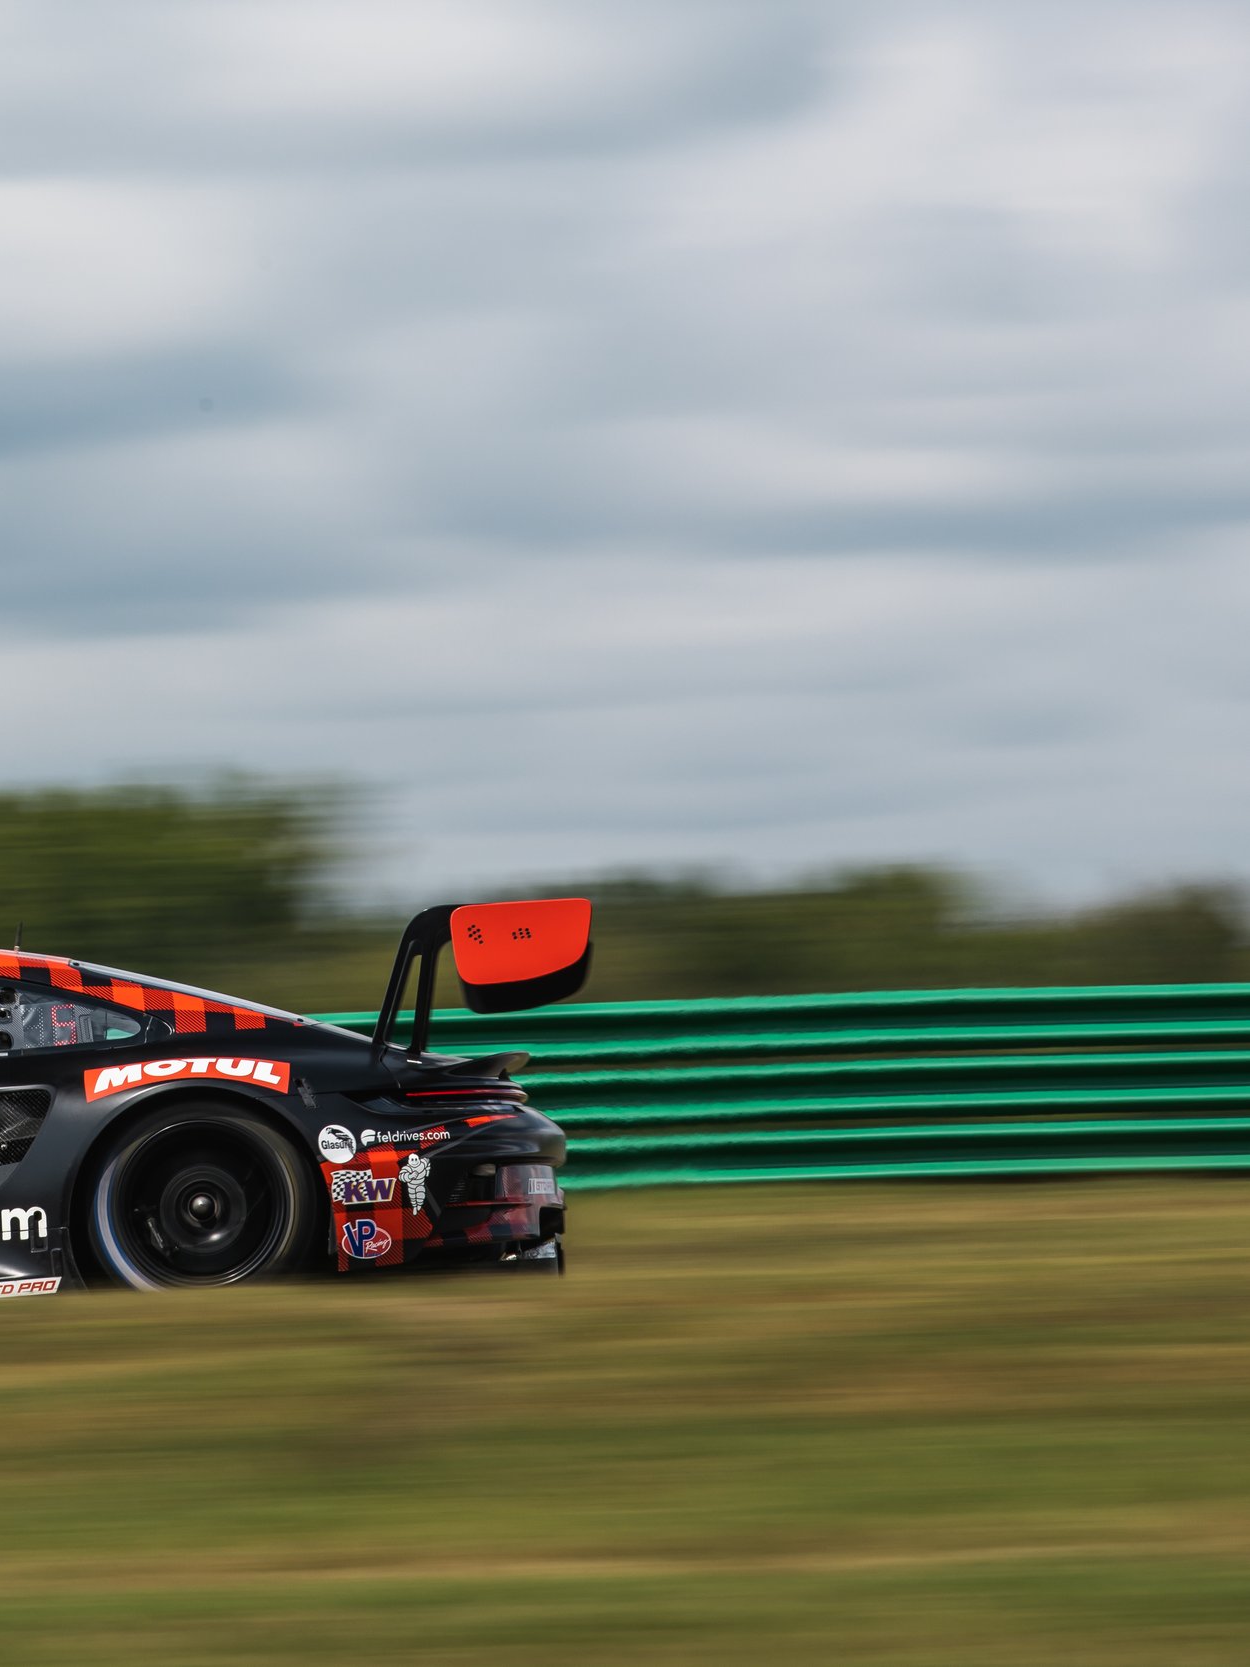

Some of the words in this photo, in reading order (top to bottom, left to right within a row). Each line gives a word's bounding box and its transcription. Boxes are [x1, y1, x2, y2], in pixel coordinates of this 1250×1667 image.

[93, 1057, 282, 1094] MOTUL
[376, 1130, 451, 1143] feldrives.com
[344, 1178, 396, 1204] KW
[343, 1219, 376, 1258] VP
[17, 1280, 57, 1294] PRO
